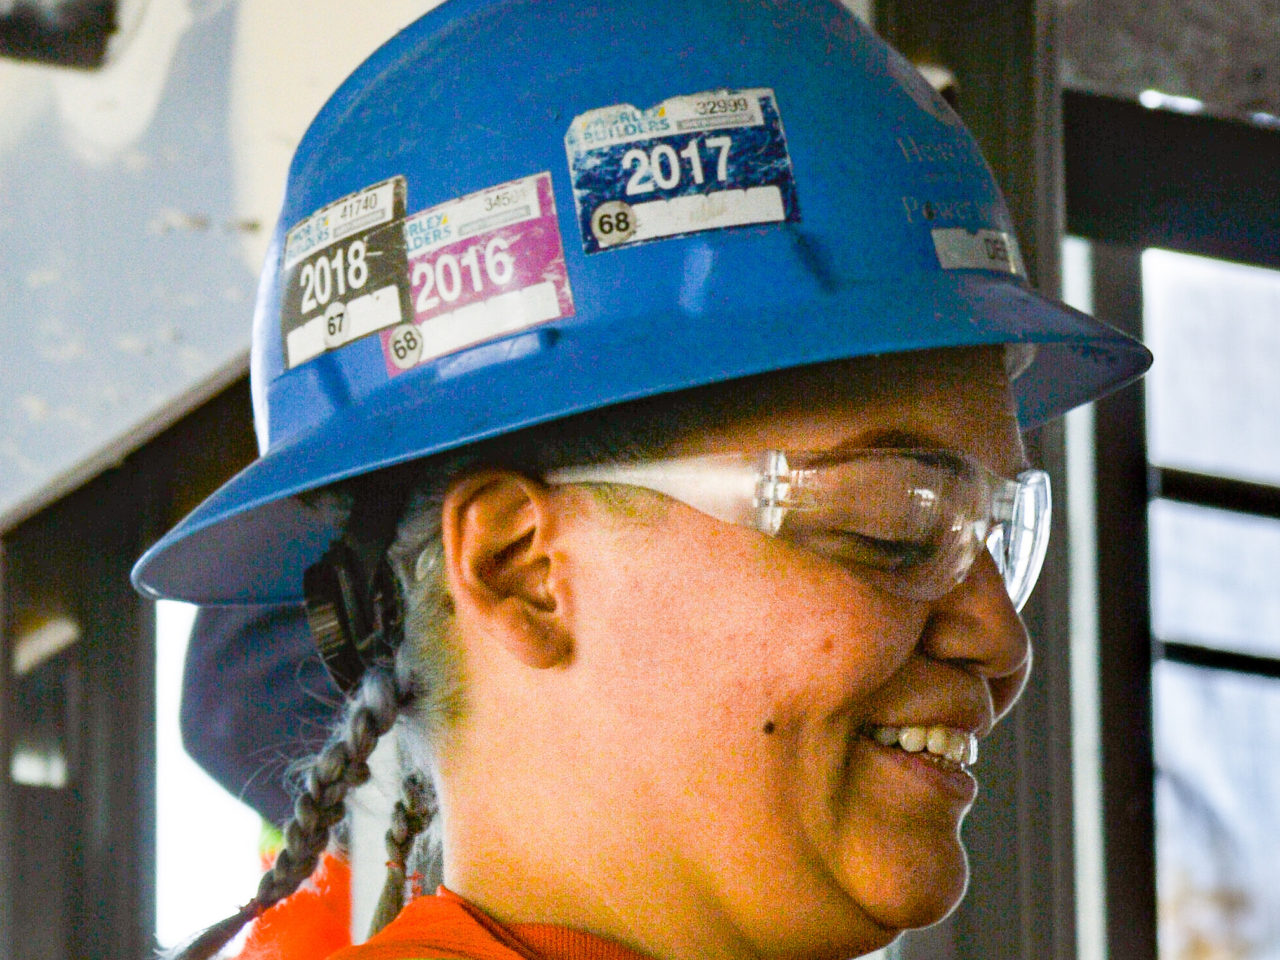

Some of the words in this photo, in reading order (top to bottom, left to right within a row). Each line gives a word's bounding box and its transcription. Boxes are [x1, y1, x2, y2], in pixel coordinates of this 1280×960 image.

[622, 136, 732, 196] 2017
[340, 193, 378, 219] 41740
[599, 212, 630, 235] 68
[300, 240, 369, 314] 2018
[412, 238, 515, 313] 2016
[327, 313, 344, 336] 67
[393, 331, 417, 360] 68
